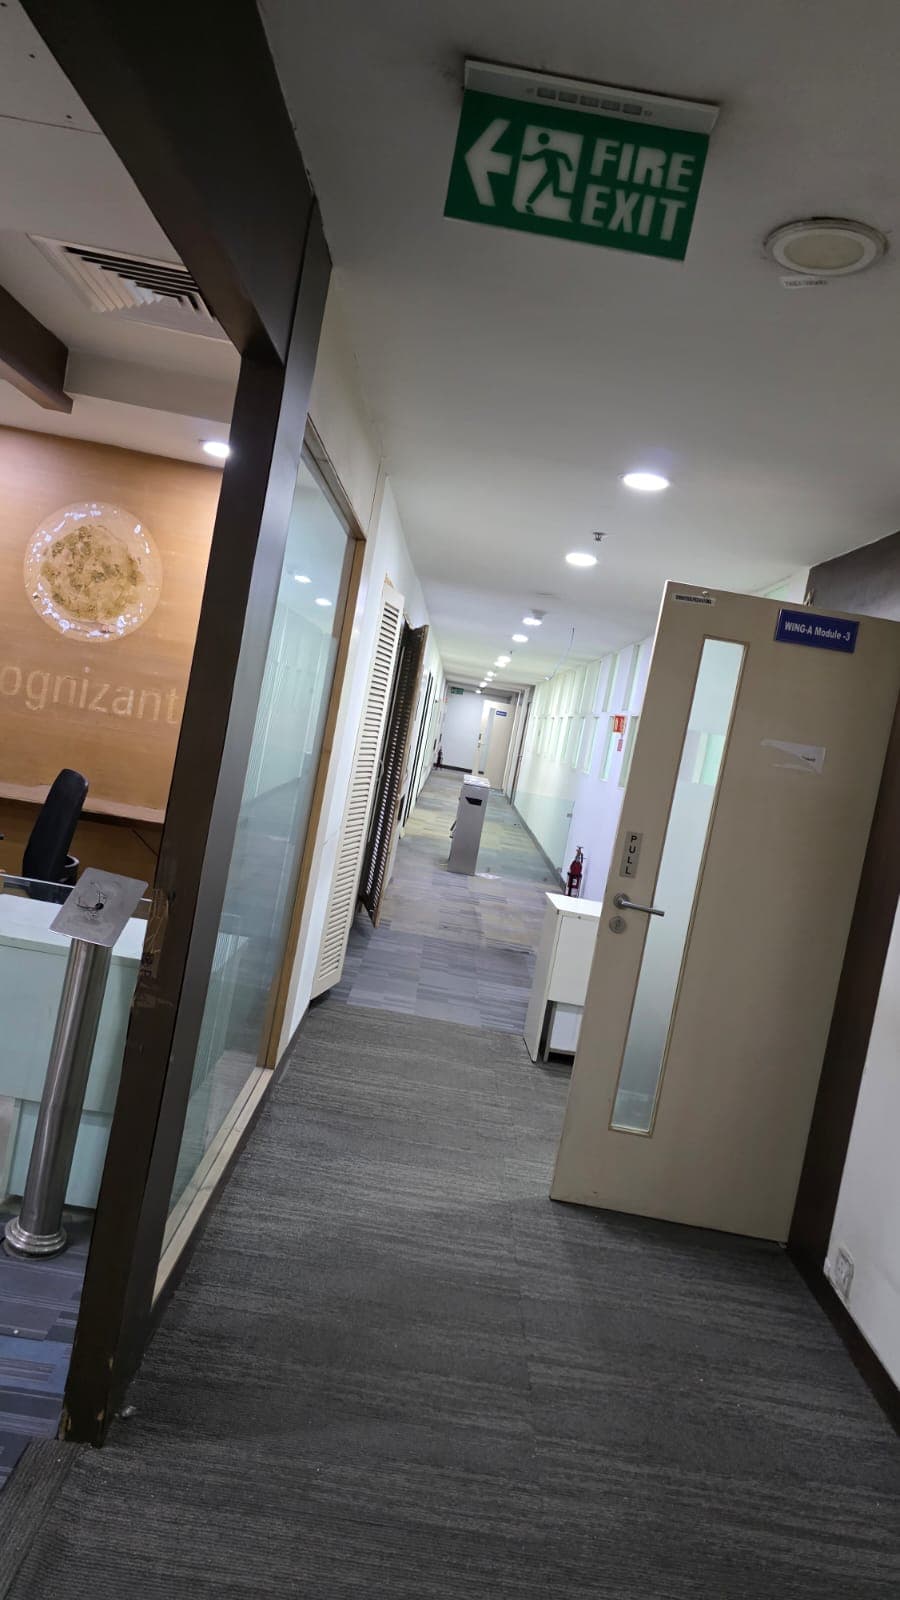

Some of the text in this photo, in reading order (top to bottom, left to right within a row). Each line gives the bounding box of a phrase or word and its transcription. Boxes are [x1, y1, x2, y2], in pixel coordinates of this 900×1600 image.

[590, 138, 696, 192] FIRE
[580, 184, 687, 241] EXIT
[784, 621, 813, 635] WING-A
[814, 626, 841, 640] Module
[625, 835, 637, 875] PULL
